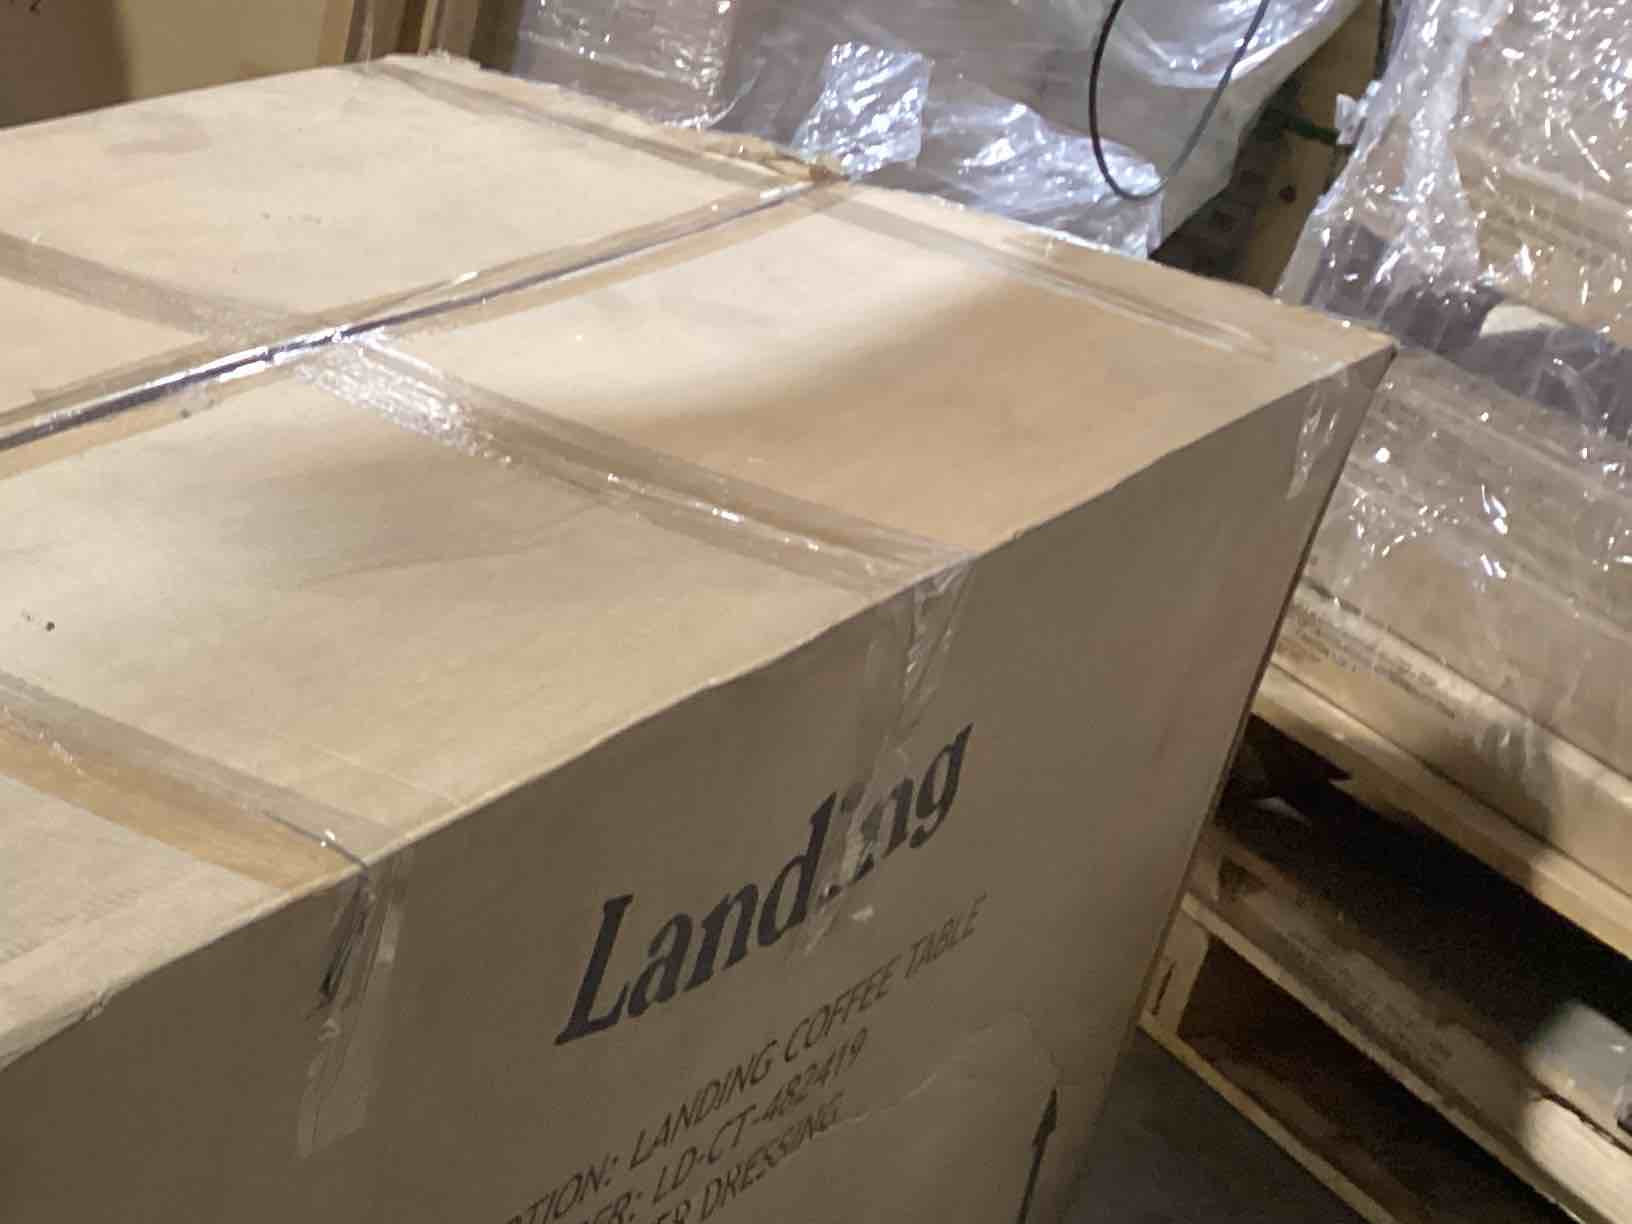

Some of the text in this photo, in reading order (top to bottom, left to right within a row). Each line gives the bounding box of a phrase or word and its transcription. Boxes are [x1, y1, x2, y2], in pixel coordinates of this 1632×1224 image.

[628, 1039, 778, 1170] LANDING
[784, 953, 903, 1063] COFFEE
[904, 891, 988, 979] TABLE
[698, 1090, 845, 1223] DRESSING
